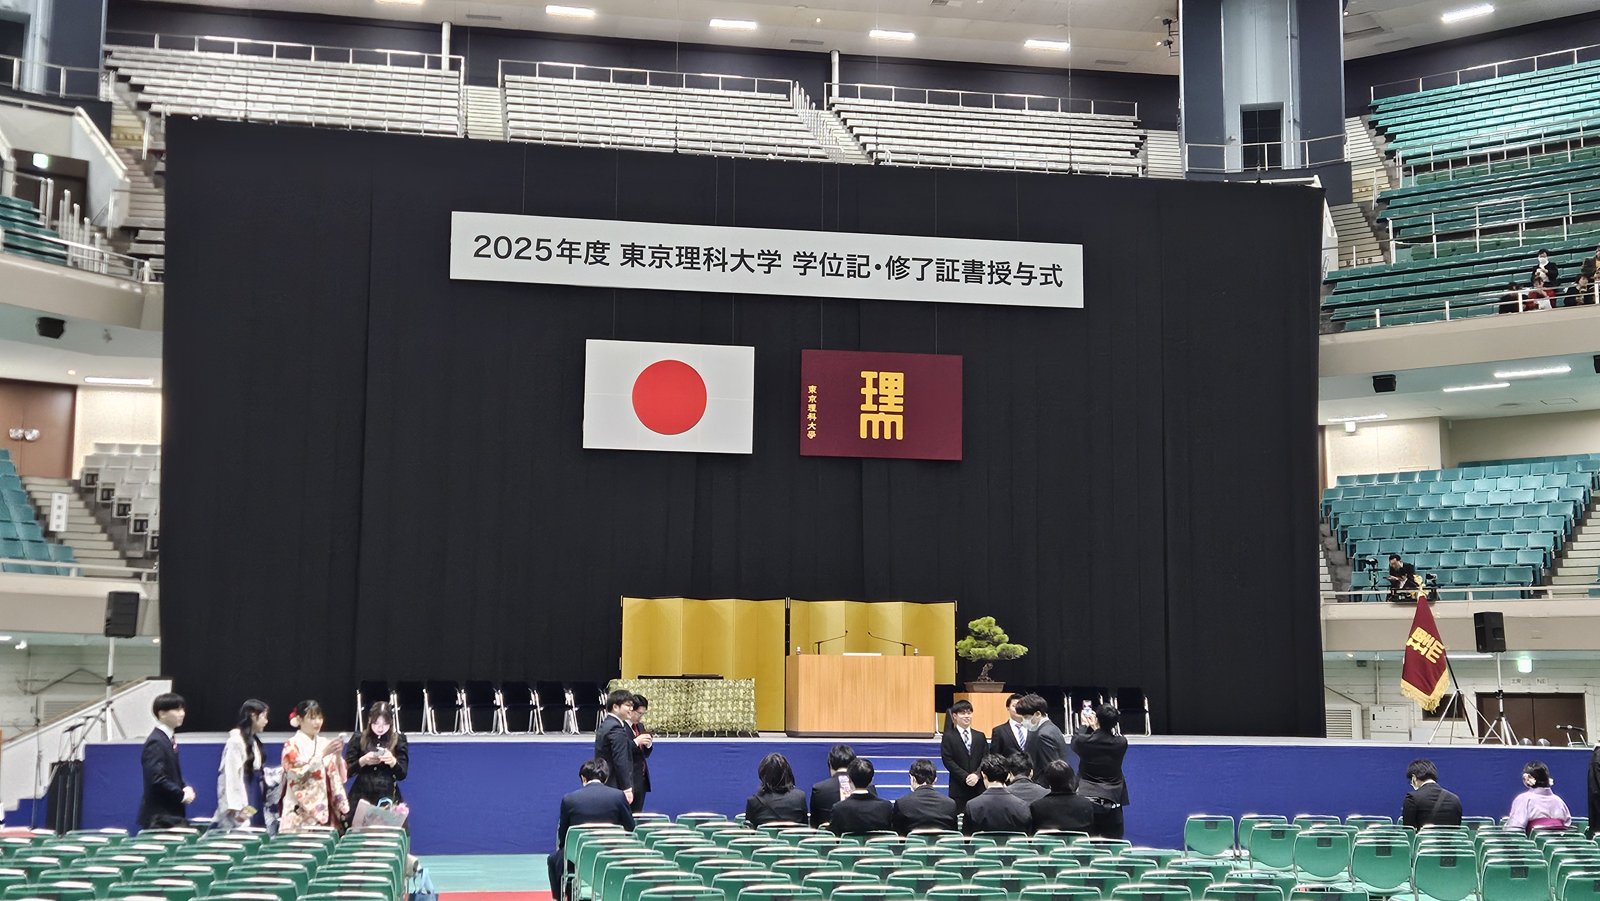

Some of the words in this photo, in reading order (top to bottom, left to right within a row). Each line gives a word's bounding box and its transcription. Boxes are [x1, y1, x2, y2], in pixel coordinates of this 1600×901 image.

[473, 234, 611, 267] 2025年度
[619, 242, 782, 275] 東京理科大学
[792, 250, 1064, 288] 学位記・修了証書授与式
